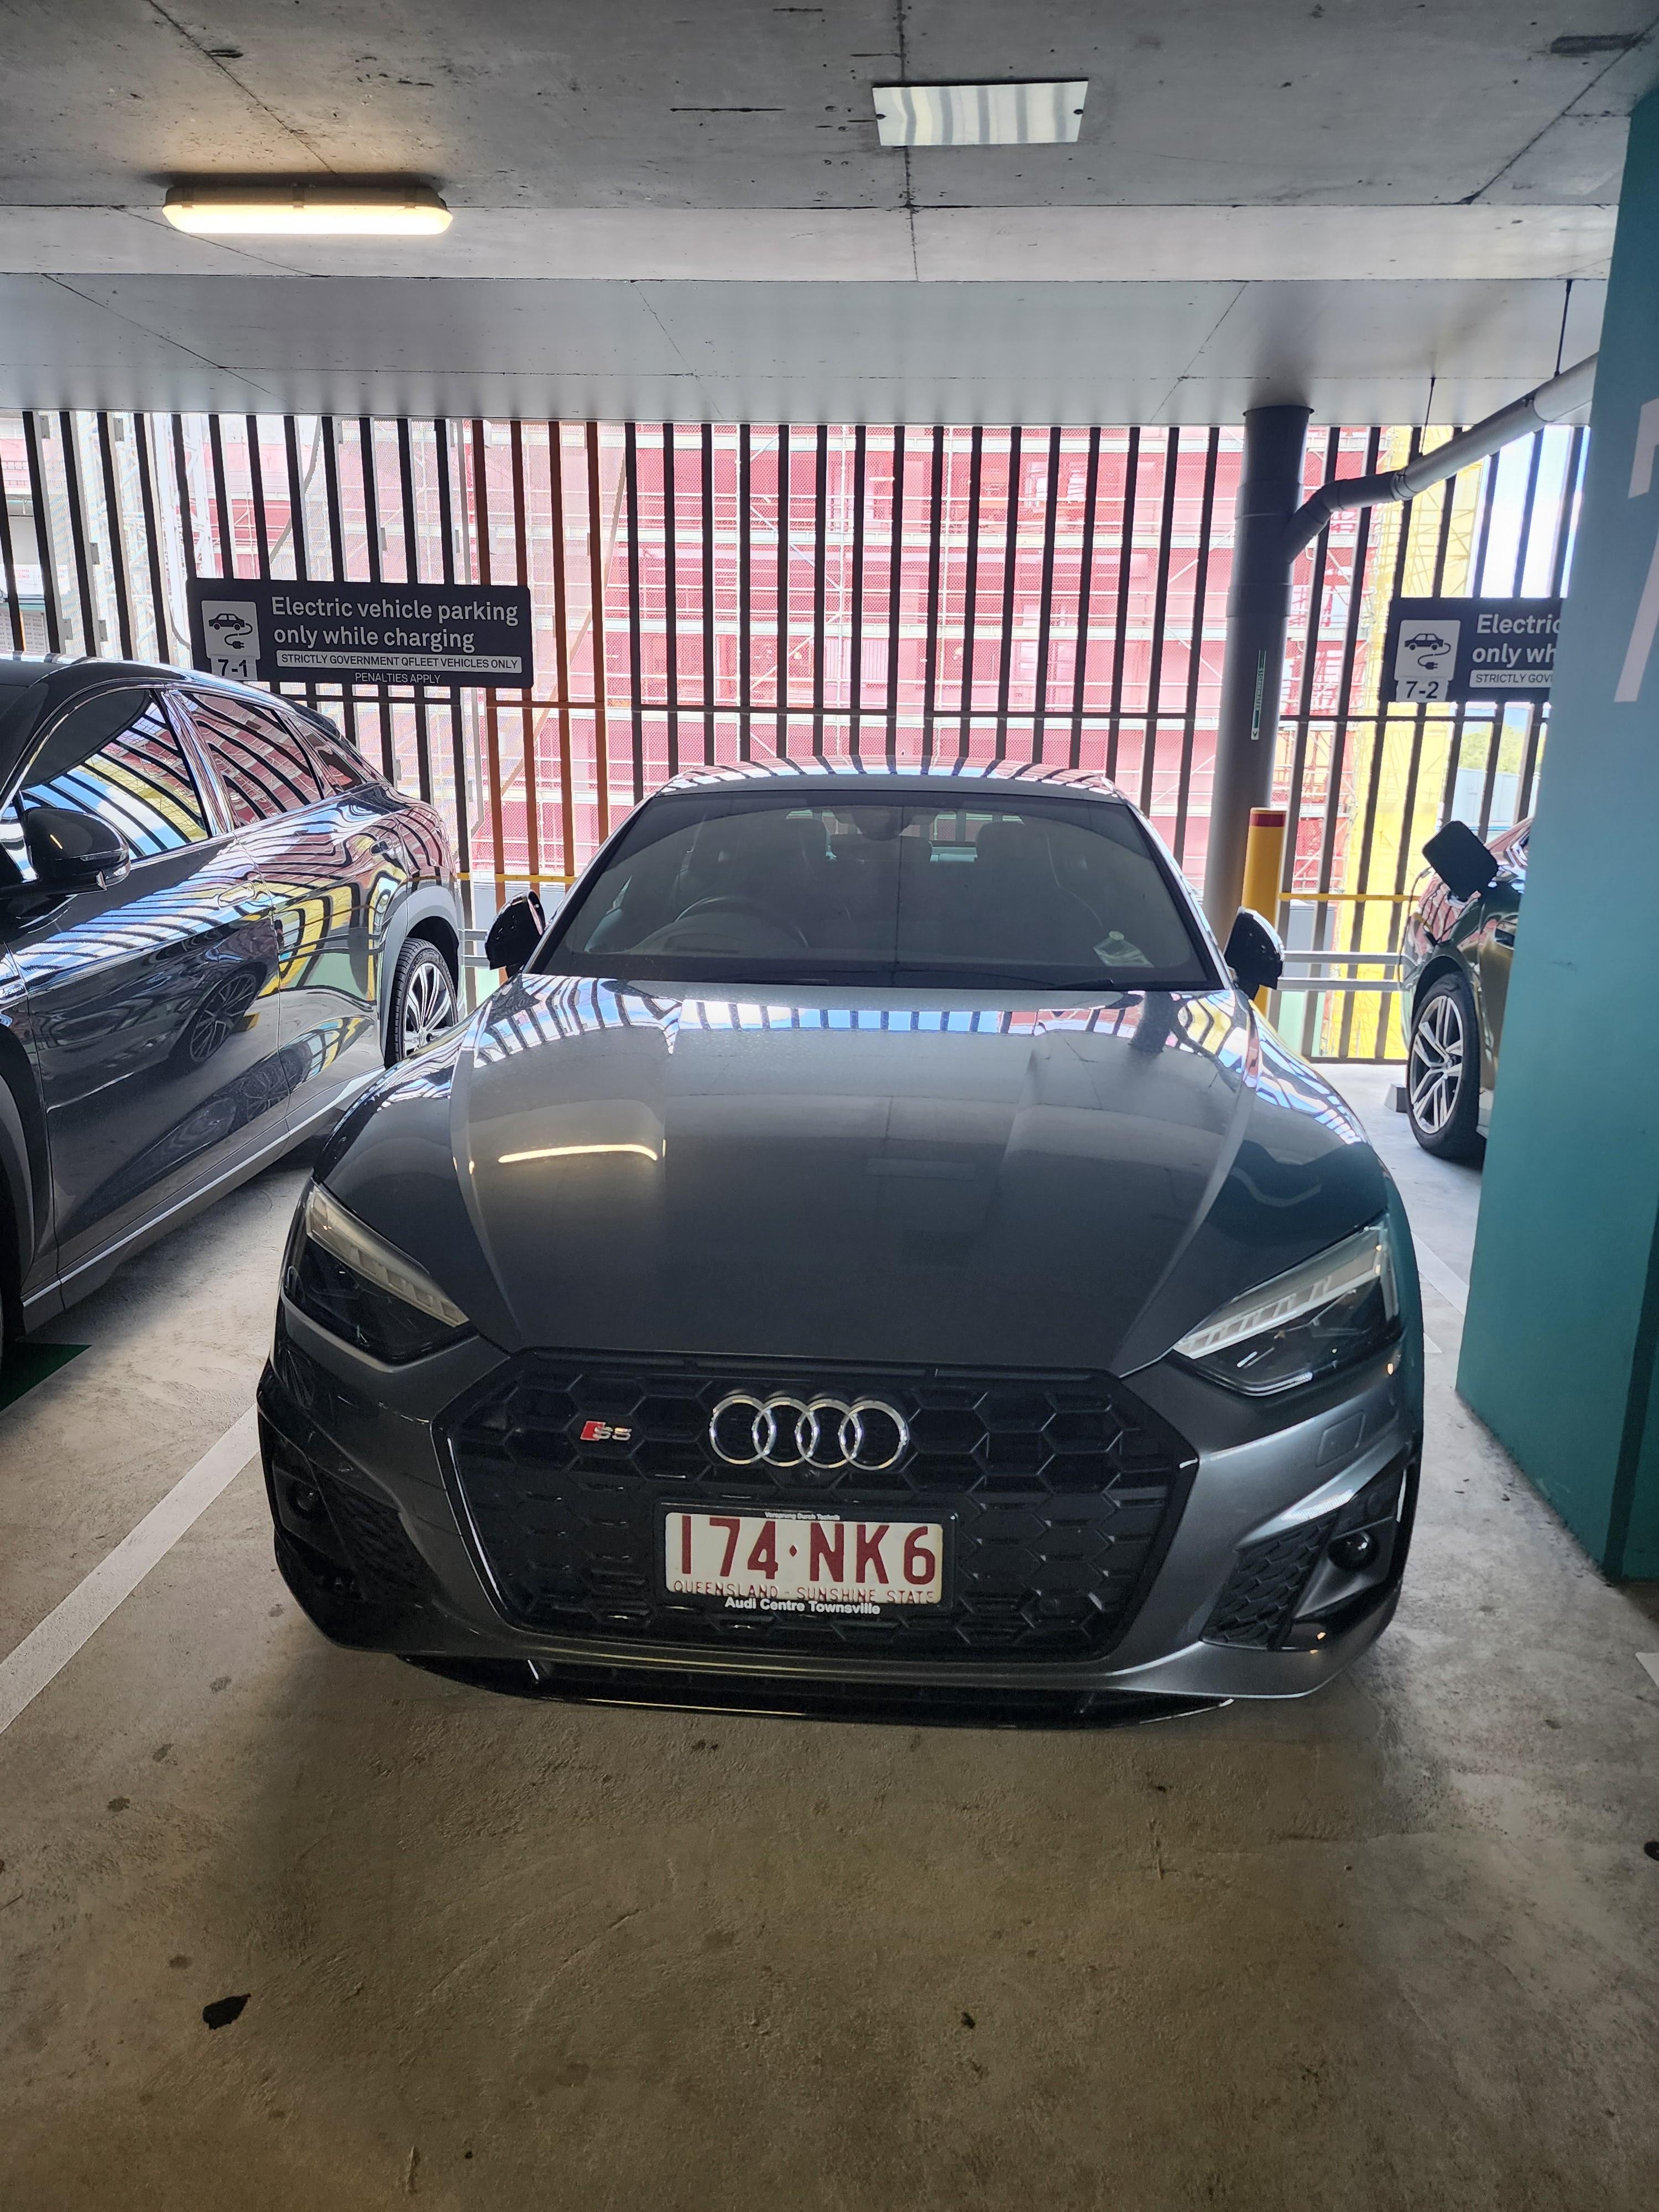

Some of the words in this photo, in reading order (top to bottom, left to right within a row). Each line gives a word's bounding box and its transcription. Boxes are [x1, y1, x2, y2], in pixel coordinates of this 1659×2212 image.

[272, 597, 353, 618] Electric
[357, 601, 432, 620] vehicle
[439, 601, 518, 626] parking
[274, 625, 320, 649] only
[323, 627, 378, 646] while
[384, 628, 474, 653] charging
[281, 654, 328, 664] STRICTLY
[331, 655, 399, 666] GOVERNMENT
[401, 657, 439, 667] QFLEET
[441, 658, 489, 669] VEHICLES
[491, 660, 518, 669] ONLY
[1472, 643, 1521, 668] only
[217, 659, 248, 677] 7-1
[355, 672, 408, 683] PENALTIES
[410, 674, 441, 685] APPLY
[1476, 674, 1526, 684] STRICTLY
[1406, 681, 1439, 700] 7-2
[592, 1426, 632, 1441] S5
[674, 1580, 778, 1598] QUEENSLAND
[797, 1587, 876, 1603] SUNSHINE
[886, 1590, 933, 1604] STATE
[725, 1597, 756, 1609] Audi
[760, 1599, 805, 1613] Centre
[808, 1600, 880, 1615] Townsville
